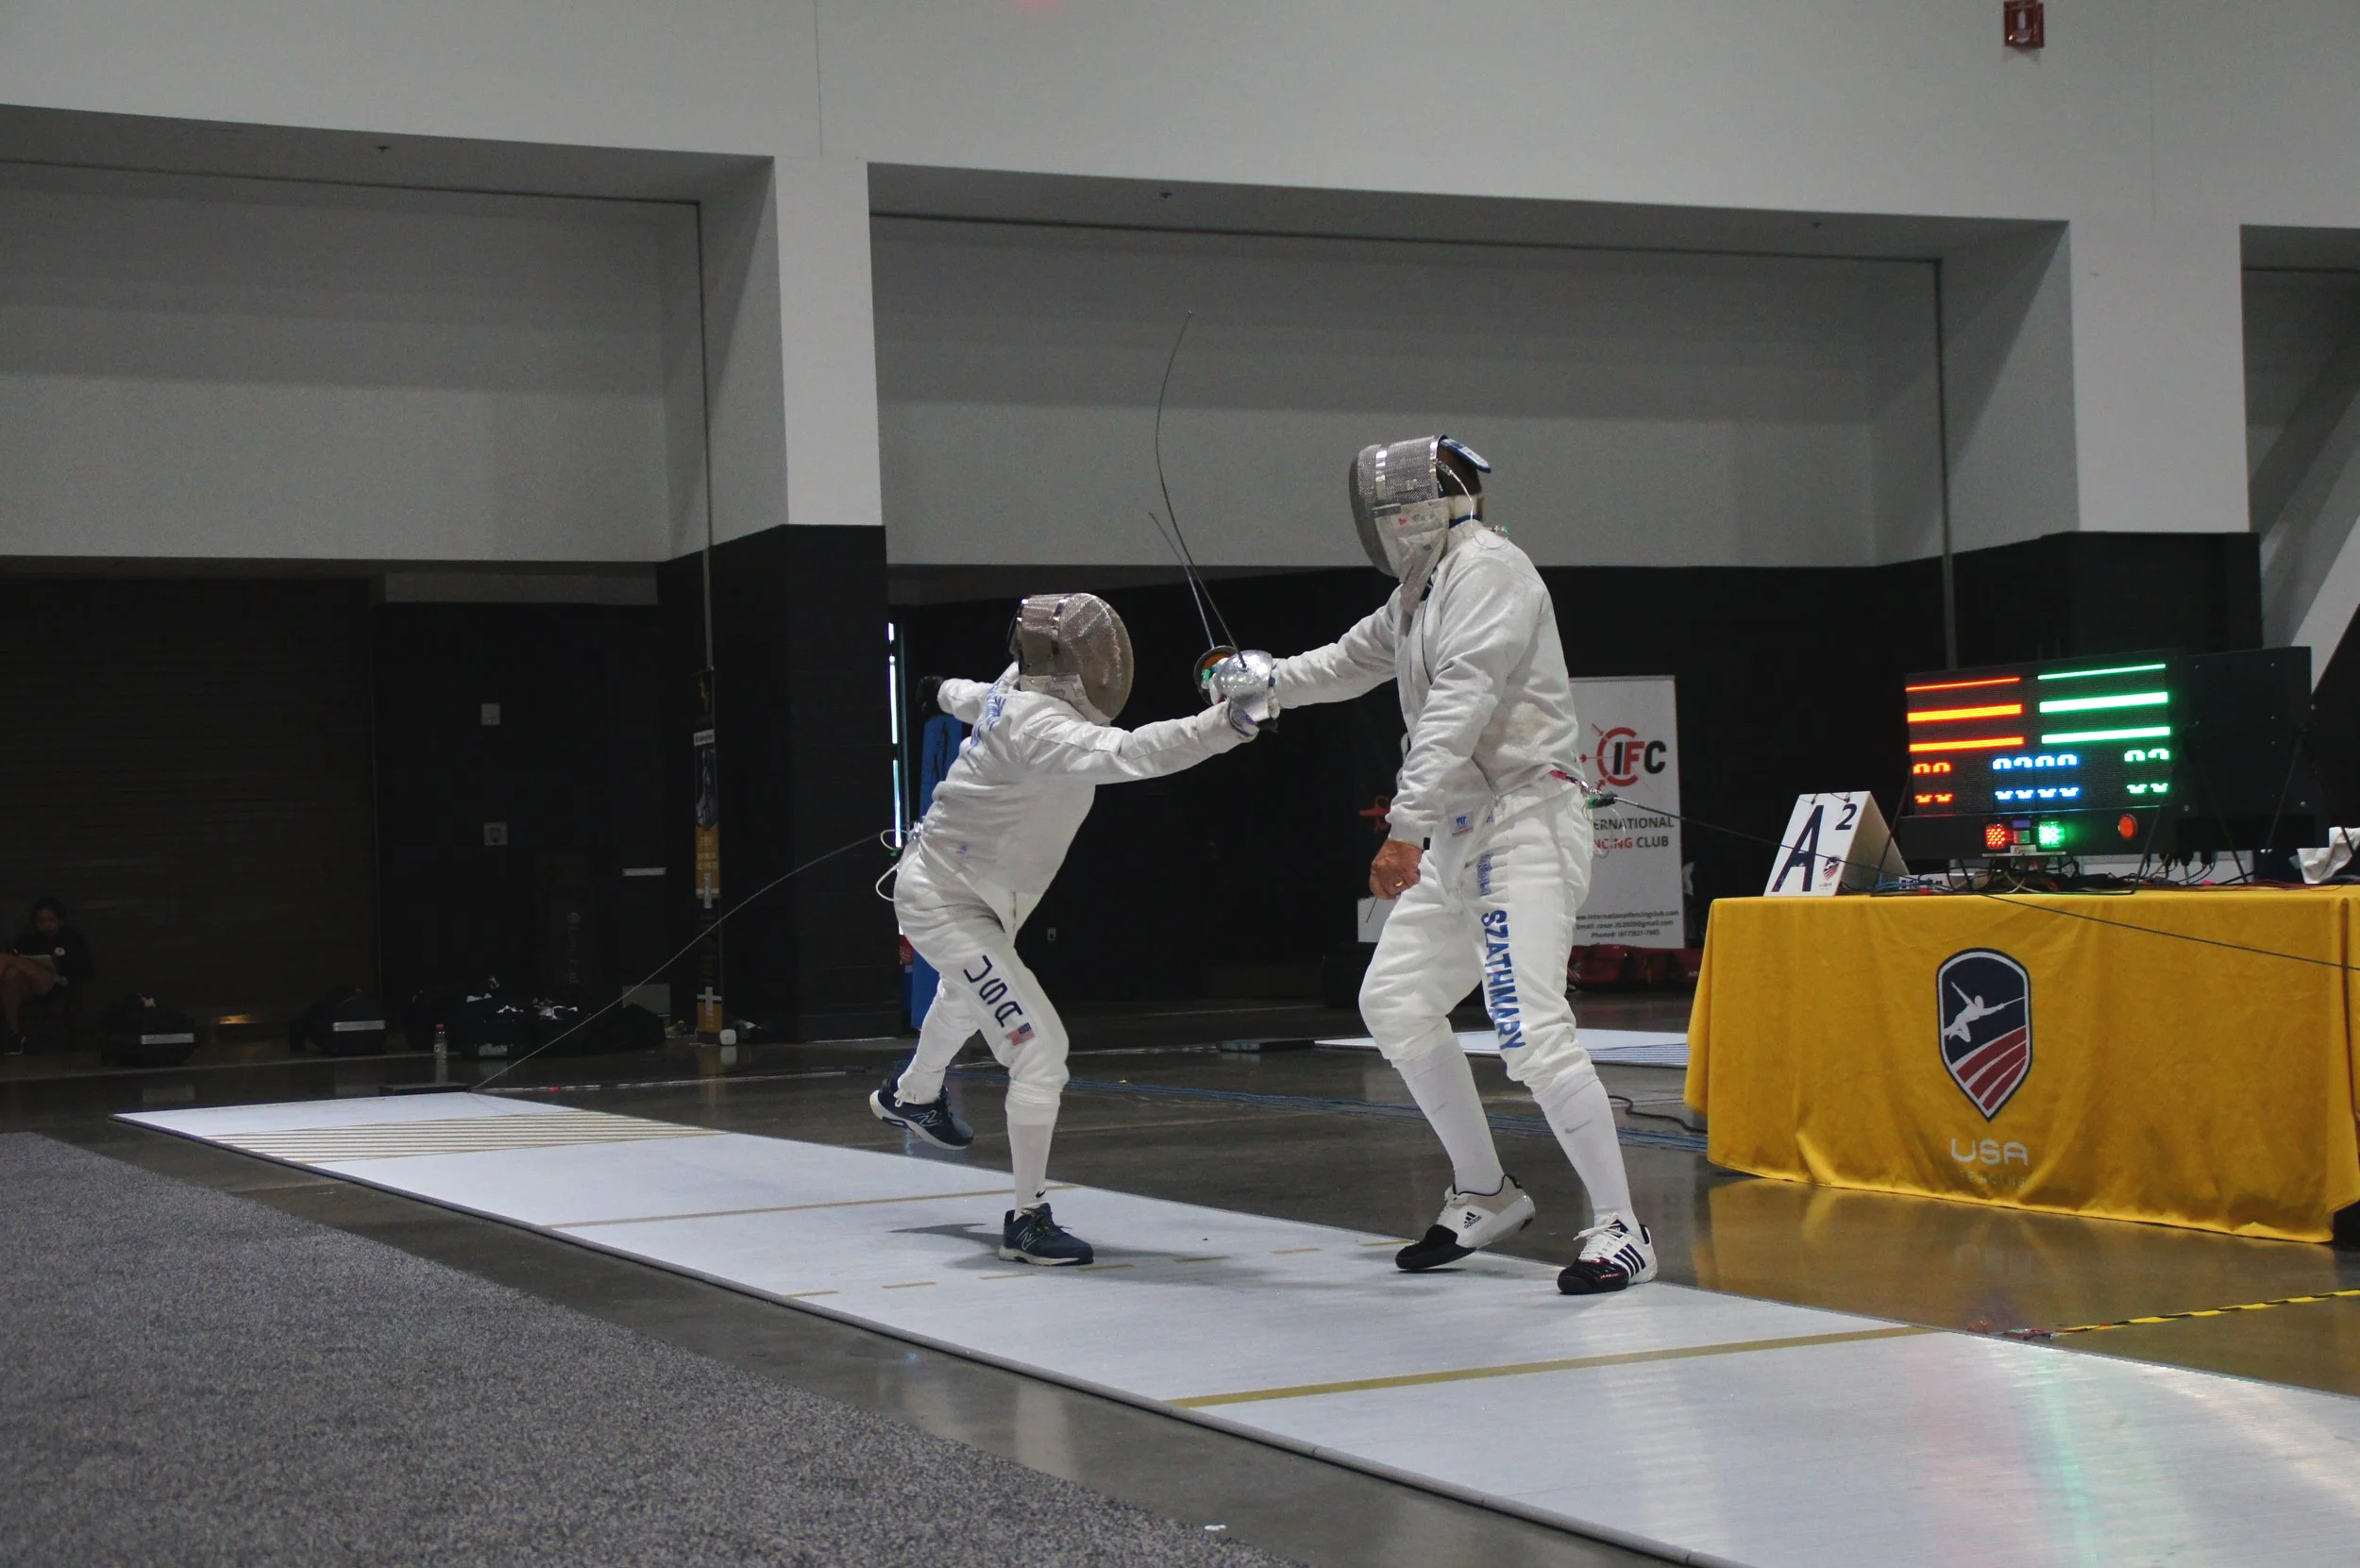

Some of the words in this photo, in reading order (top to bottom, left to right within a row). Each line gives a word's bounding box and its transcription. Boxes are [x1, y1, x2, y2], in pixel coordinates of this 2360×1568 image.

[1612, 740, 1667, 775] IFC
[1593, 816, 1675, 830] ERNATIONAL
[1636, 835, 1670, 848] CLUB
[1771, 804, 1825, 892] A
[1834, 802, 1858, 831] 2
[963, 954, 1023, 1028] USA
[1480, 909, 1526, 1051] SZATHMARY
[1950, 1138, 2029, 1167] USA
[1463, 1215, 1483, 1229] adidas
